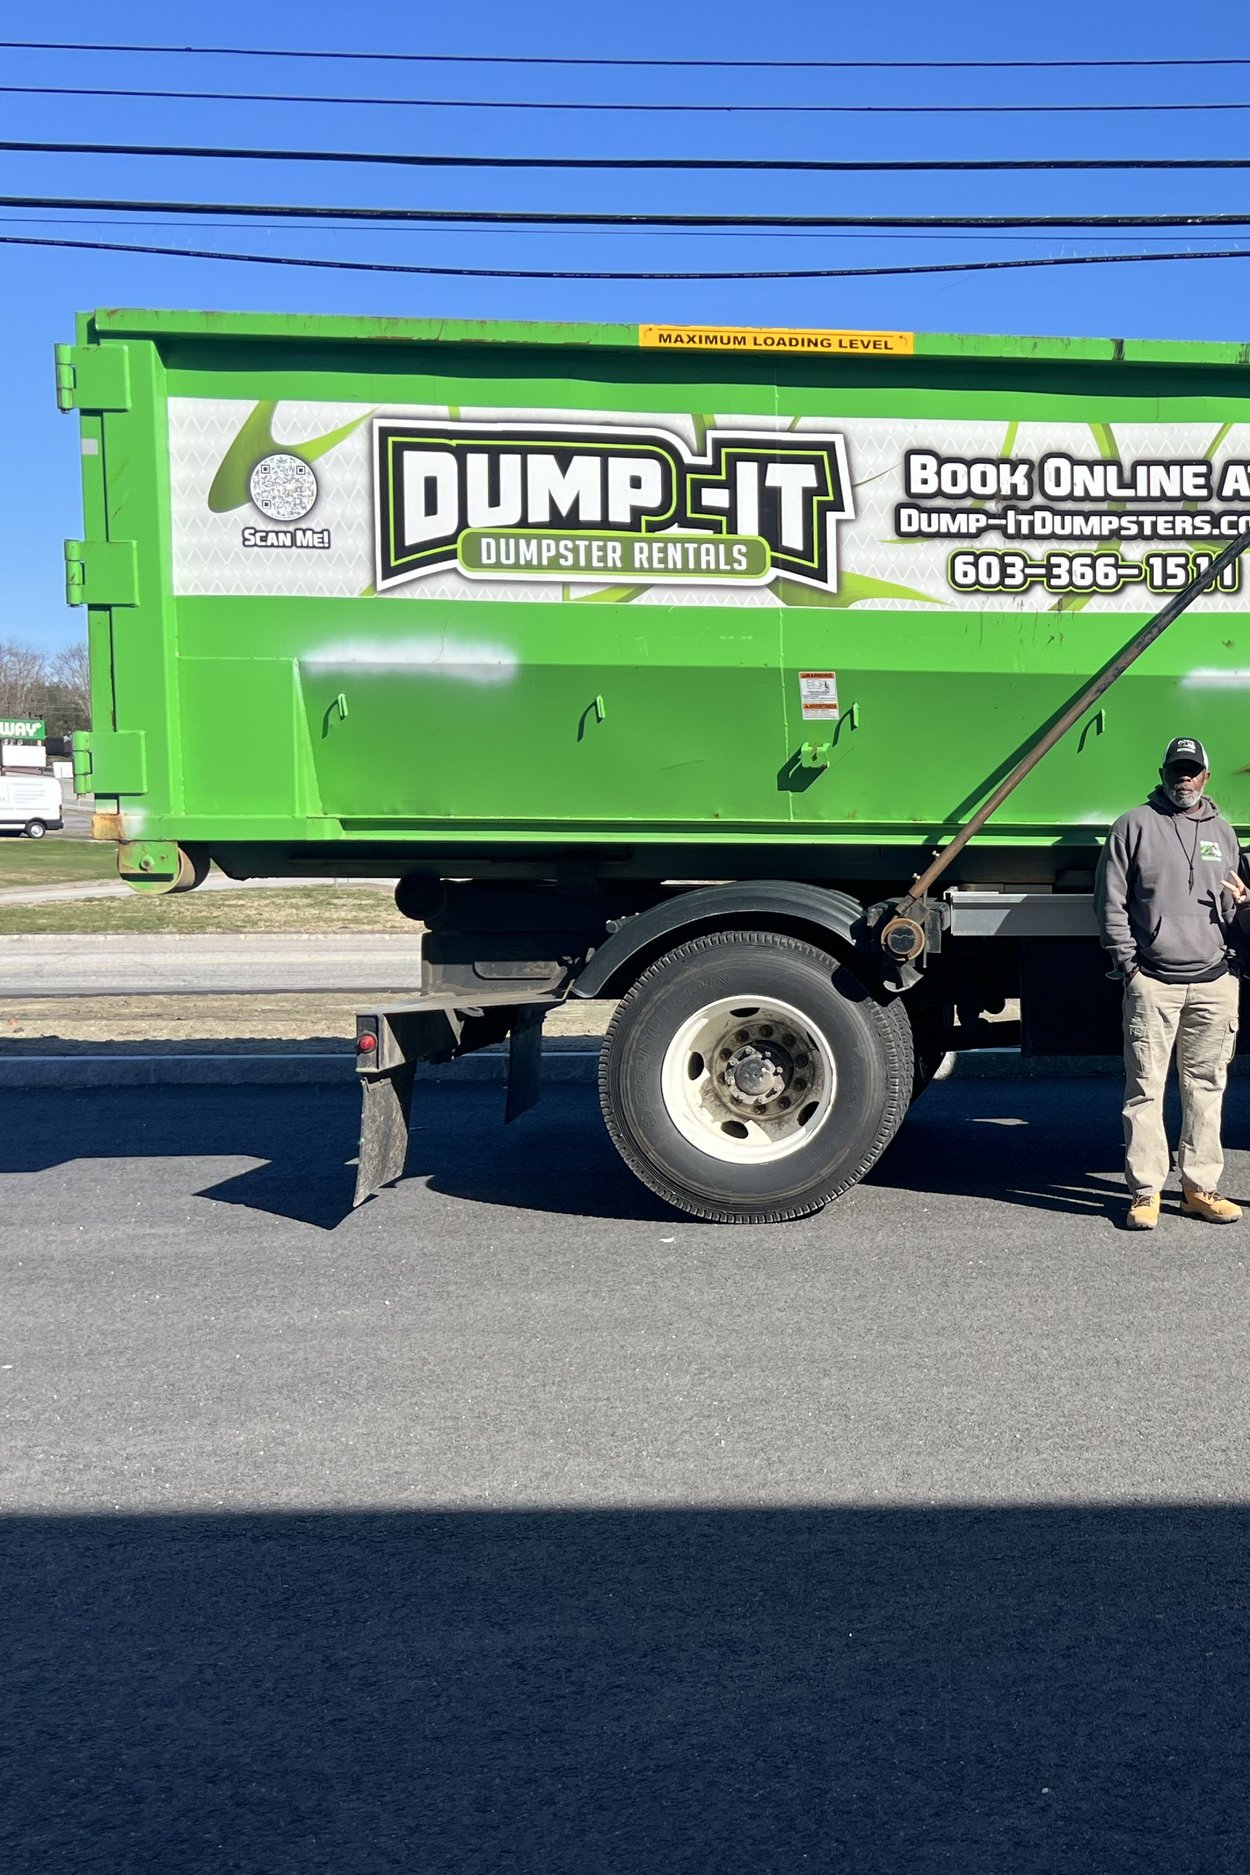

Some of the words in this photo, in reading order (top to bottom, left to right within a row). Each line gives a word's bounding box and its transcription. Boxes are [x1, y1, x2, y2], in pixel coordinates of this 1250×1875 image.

[658, 332, 747, 346] MAXIMUM
[752, 336, 832, 349] LOADING
[838, 338, 894, 351] LEVEL
[908, 454, 1030, 498] BOOK
[1044, 457, 1209, 497] ONLINE
[403, 450, 818, 551] DUMP-IT
[243, 528, 292, 547] SCAN
[295, 529, 330, 548] ME!
[480, 537, 624, 569] DUMPSTER
[633, 540, 748, 571] RENTALS
